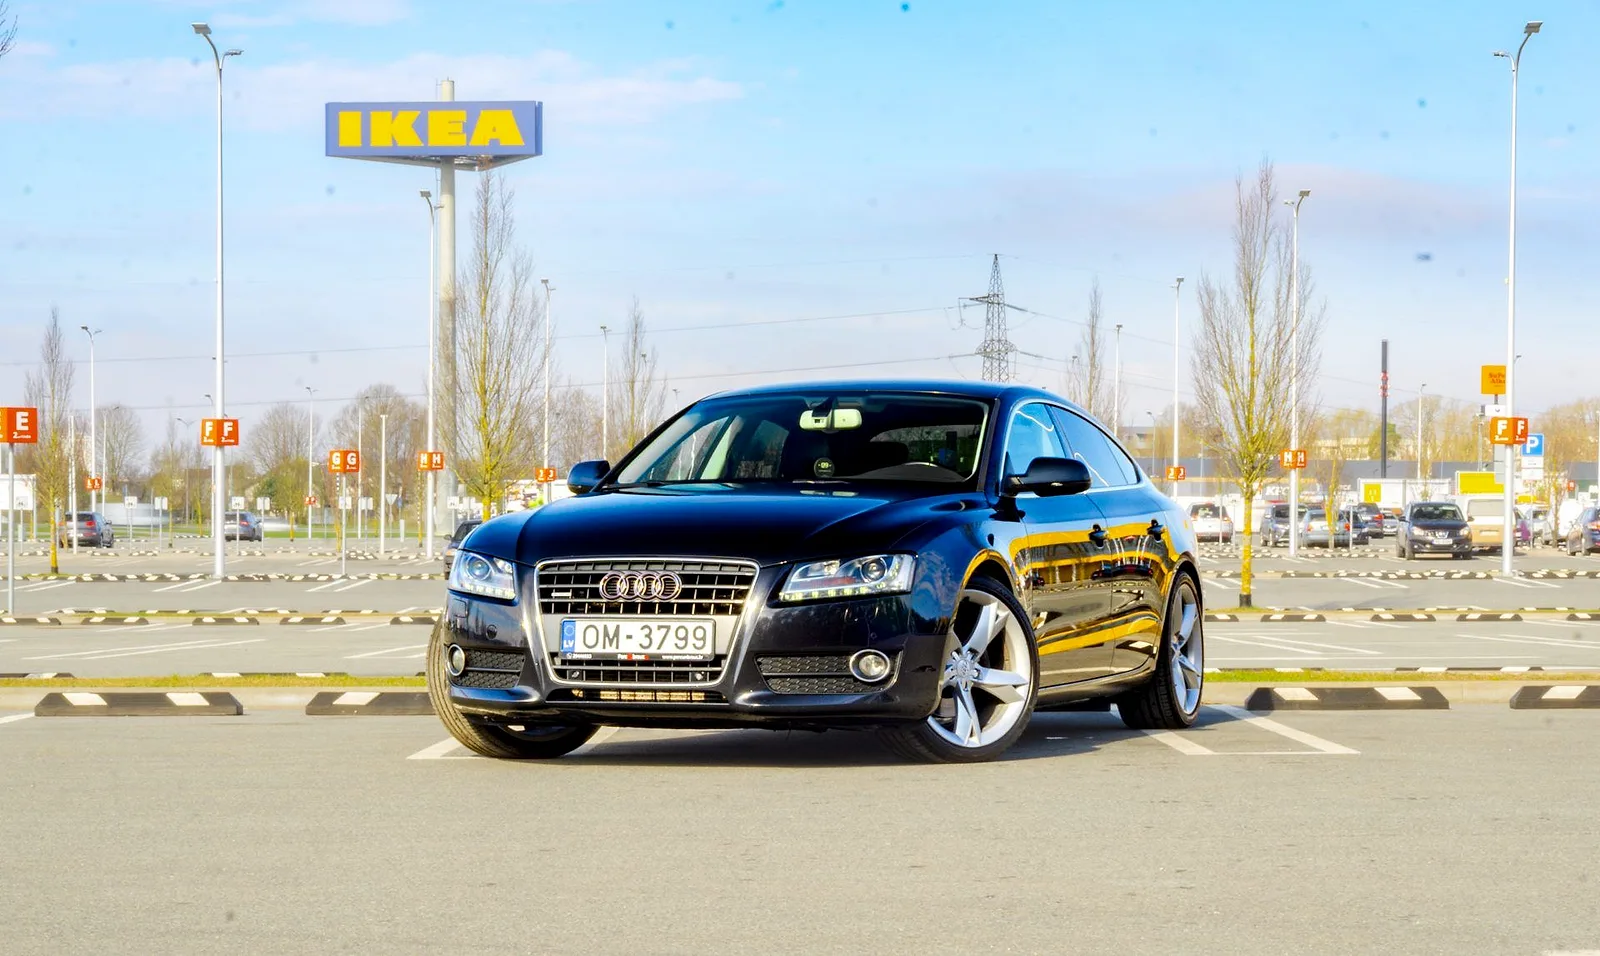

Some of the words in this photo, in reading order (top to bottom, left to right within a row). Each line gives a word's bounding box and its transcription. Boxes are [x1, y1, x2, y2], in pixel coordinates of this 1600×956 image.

[338, 109, 525, 147] IKEA
[16, 411, 29, 431] E
[1497, 420, 1508, 435] F
[1517, 420, 1525, 435] F
[205, 421, 213, 437] F
[223, 421, 234, 437] F
[1526, 436, 1539, 454] P
[332, 452, 341, 465] G
[347, 452, 357, 465] G
[420, 453, 428, 464] H
[432, 453, 441, 464] H
[1283, 451, 1293, 463] H
[1297, 451, 1305, 463] H
[1265, 486, 1290, 496] KFC
[563, 639, 574, 648] LV
[583, 624, 707, 651] OM-3799
